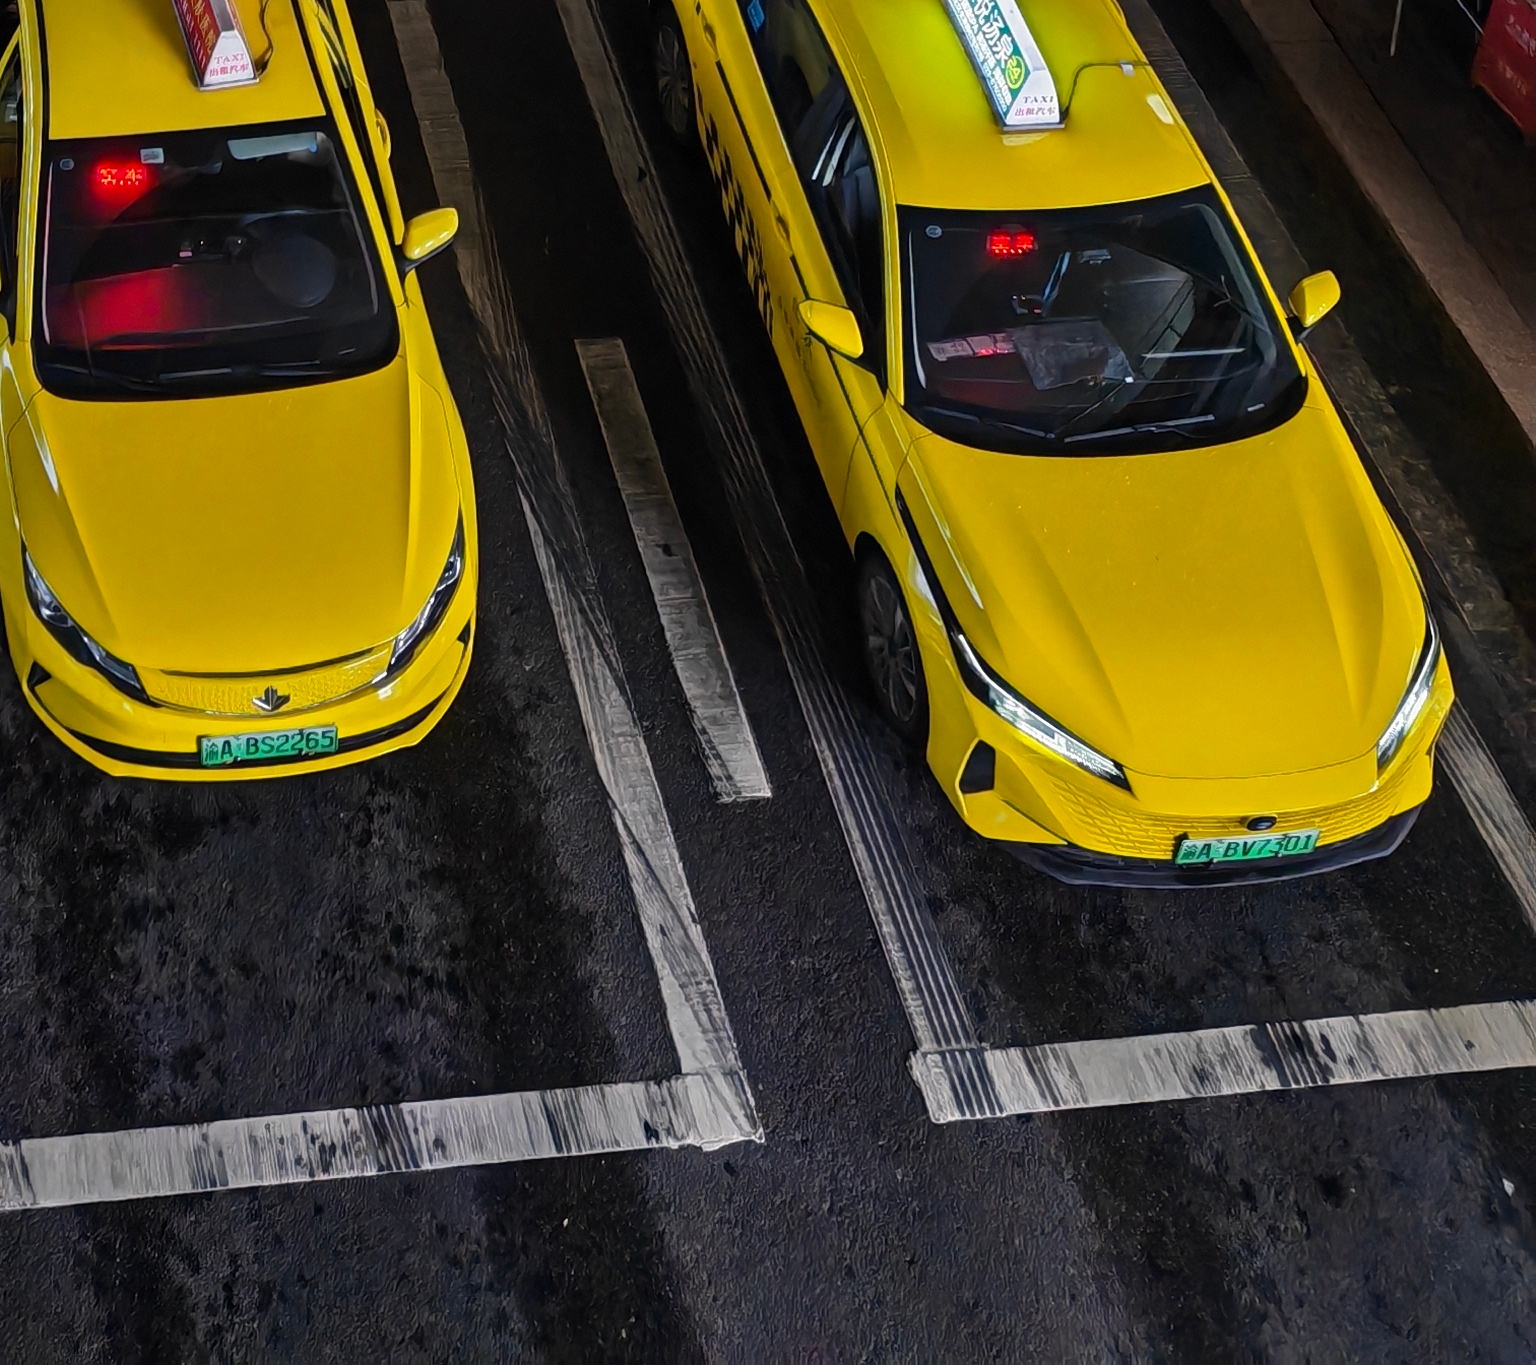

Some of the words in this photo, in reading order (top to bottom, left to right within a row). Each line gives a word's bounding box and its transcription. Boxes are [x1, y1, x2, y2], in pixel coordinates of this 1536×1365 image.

[214, 52, 244, 65] TAXI
[1022, 95, 1054, 105] TAXI
[1014, 106, 1056, 117] 出租汽车
